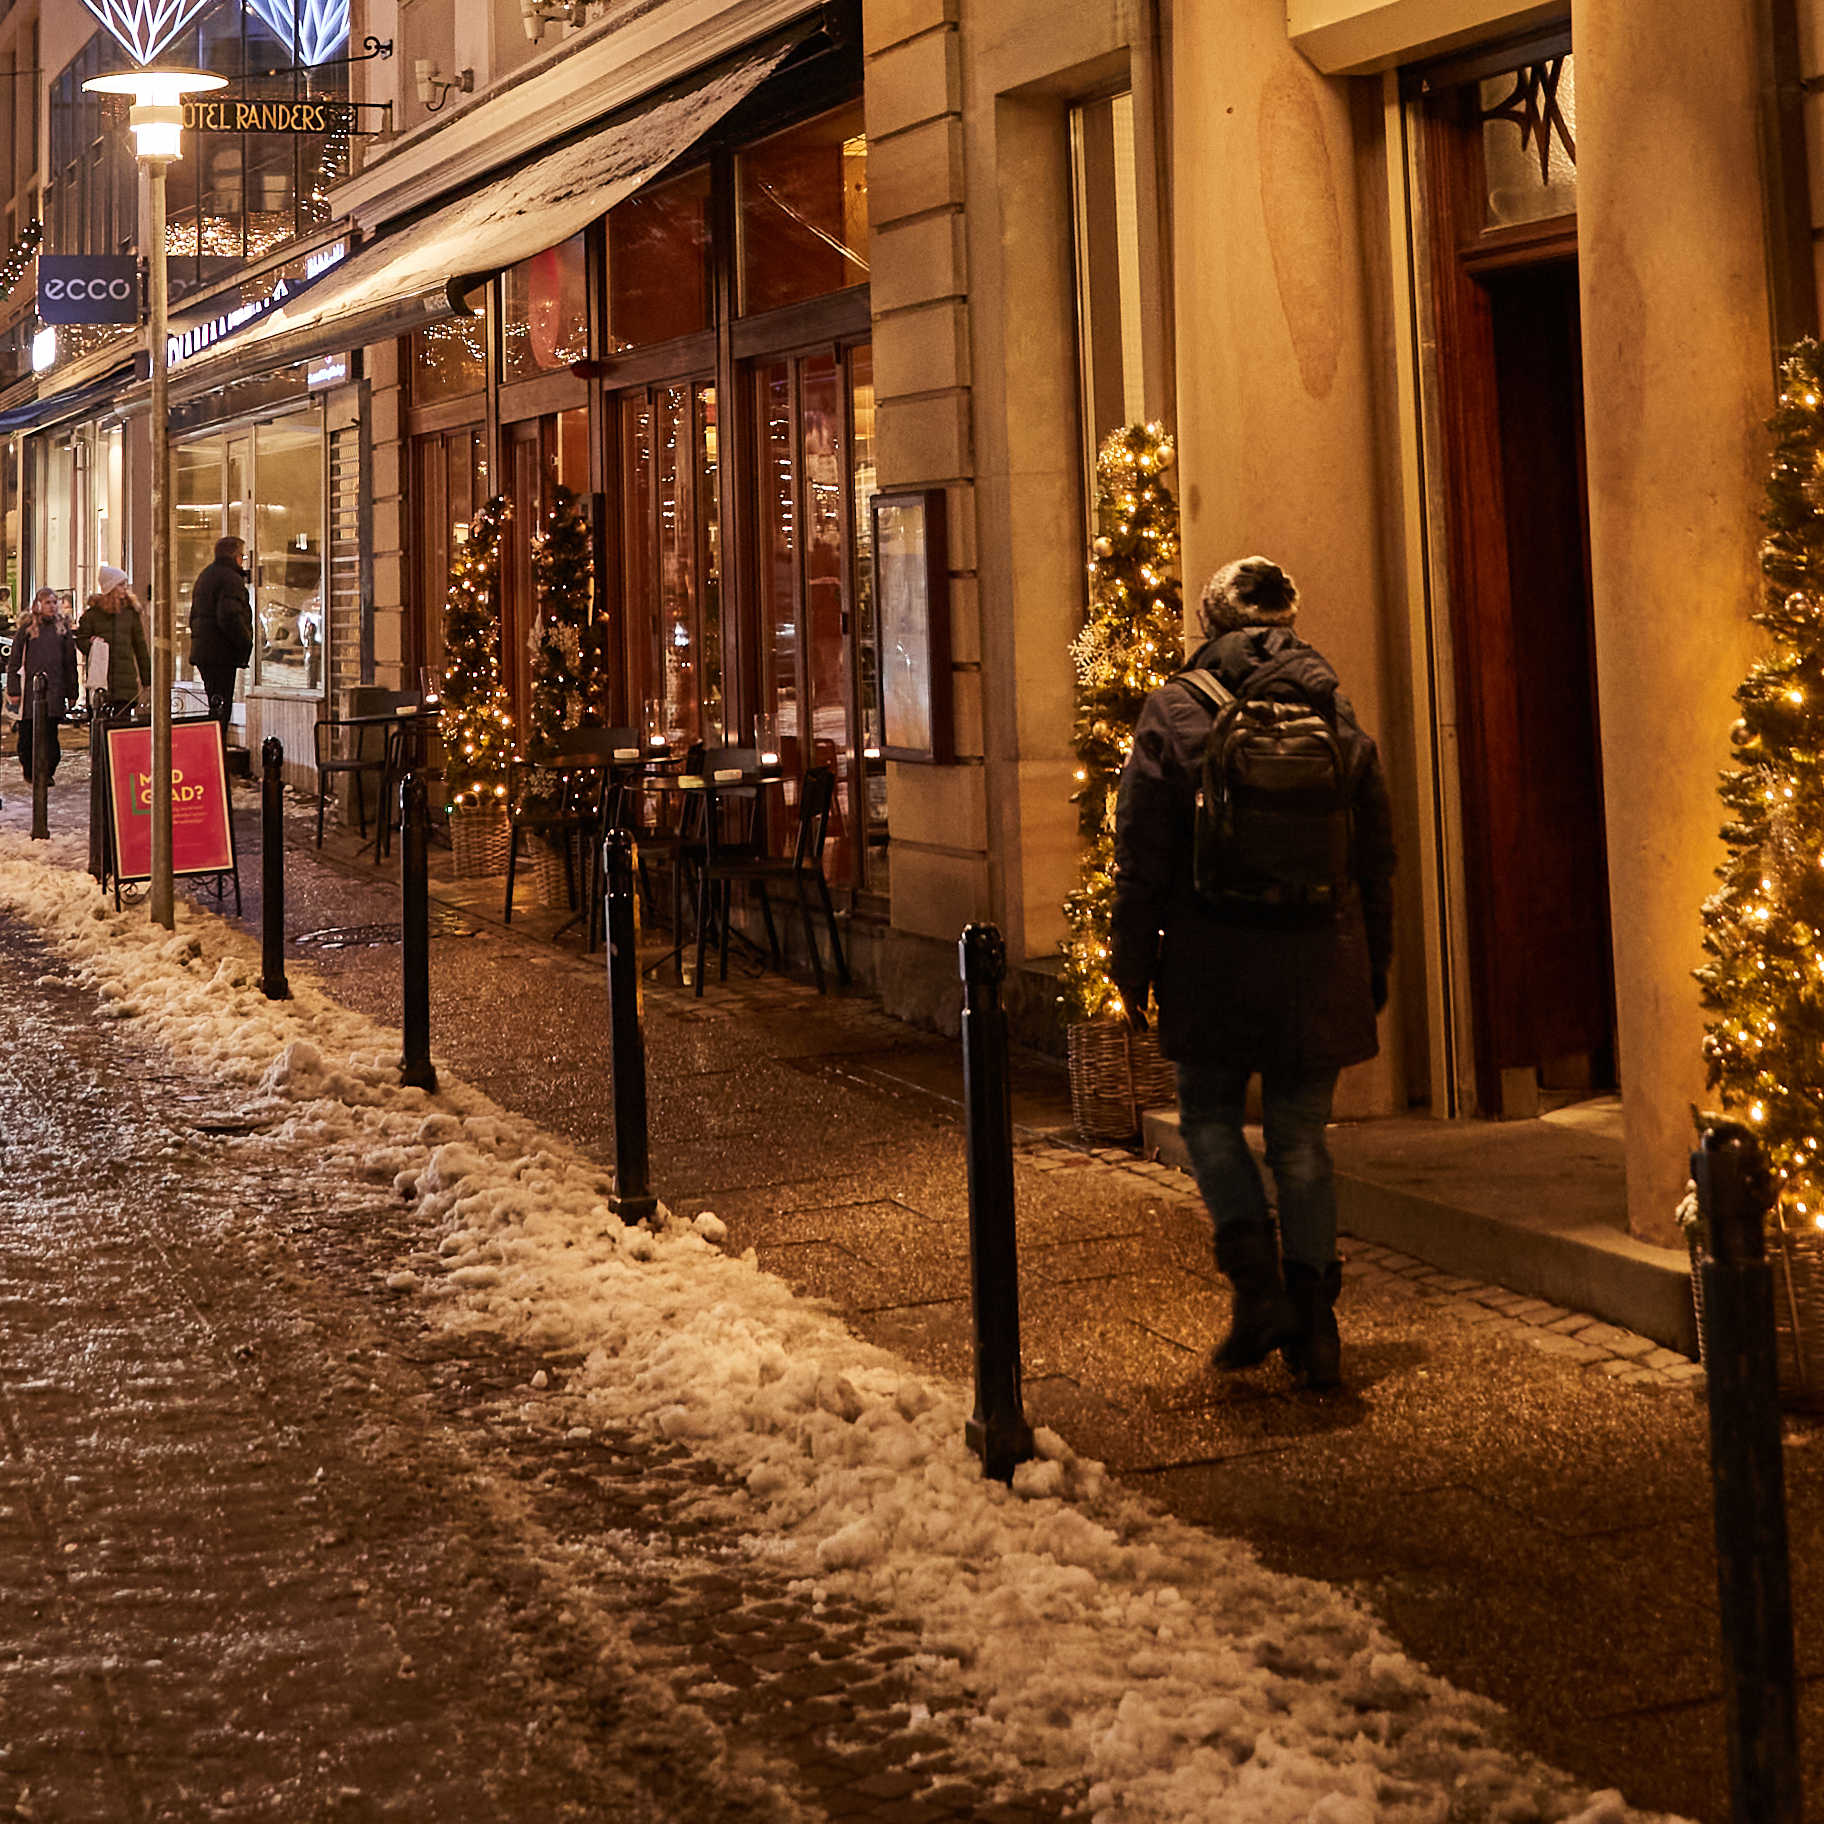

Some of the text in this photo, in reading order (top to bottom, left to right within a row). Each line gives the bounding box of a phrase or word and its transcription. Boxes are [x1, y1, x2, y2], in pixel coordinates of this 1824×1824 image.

[183, 102, 326, 131] OTEL RANDERS
[45, 278, 130, 300] ecco
[139, 769, 183, 786] MD
[141, 785, 204, 804] GAD?
